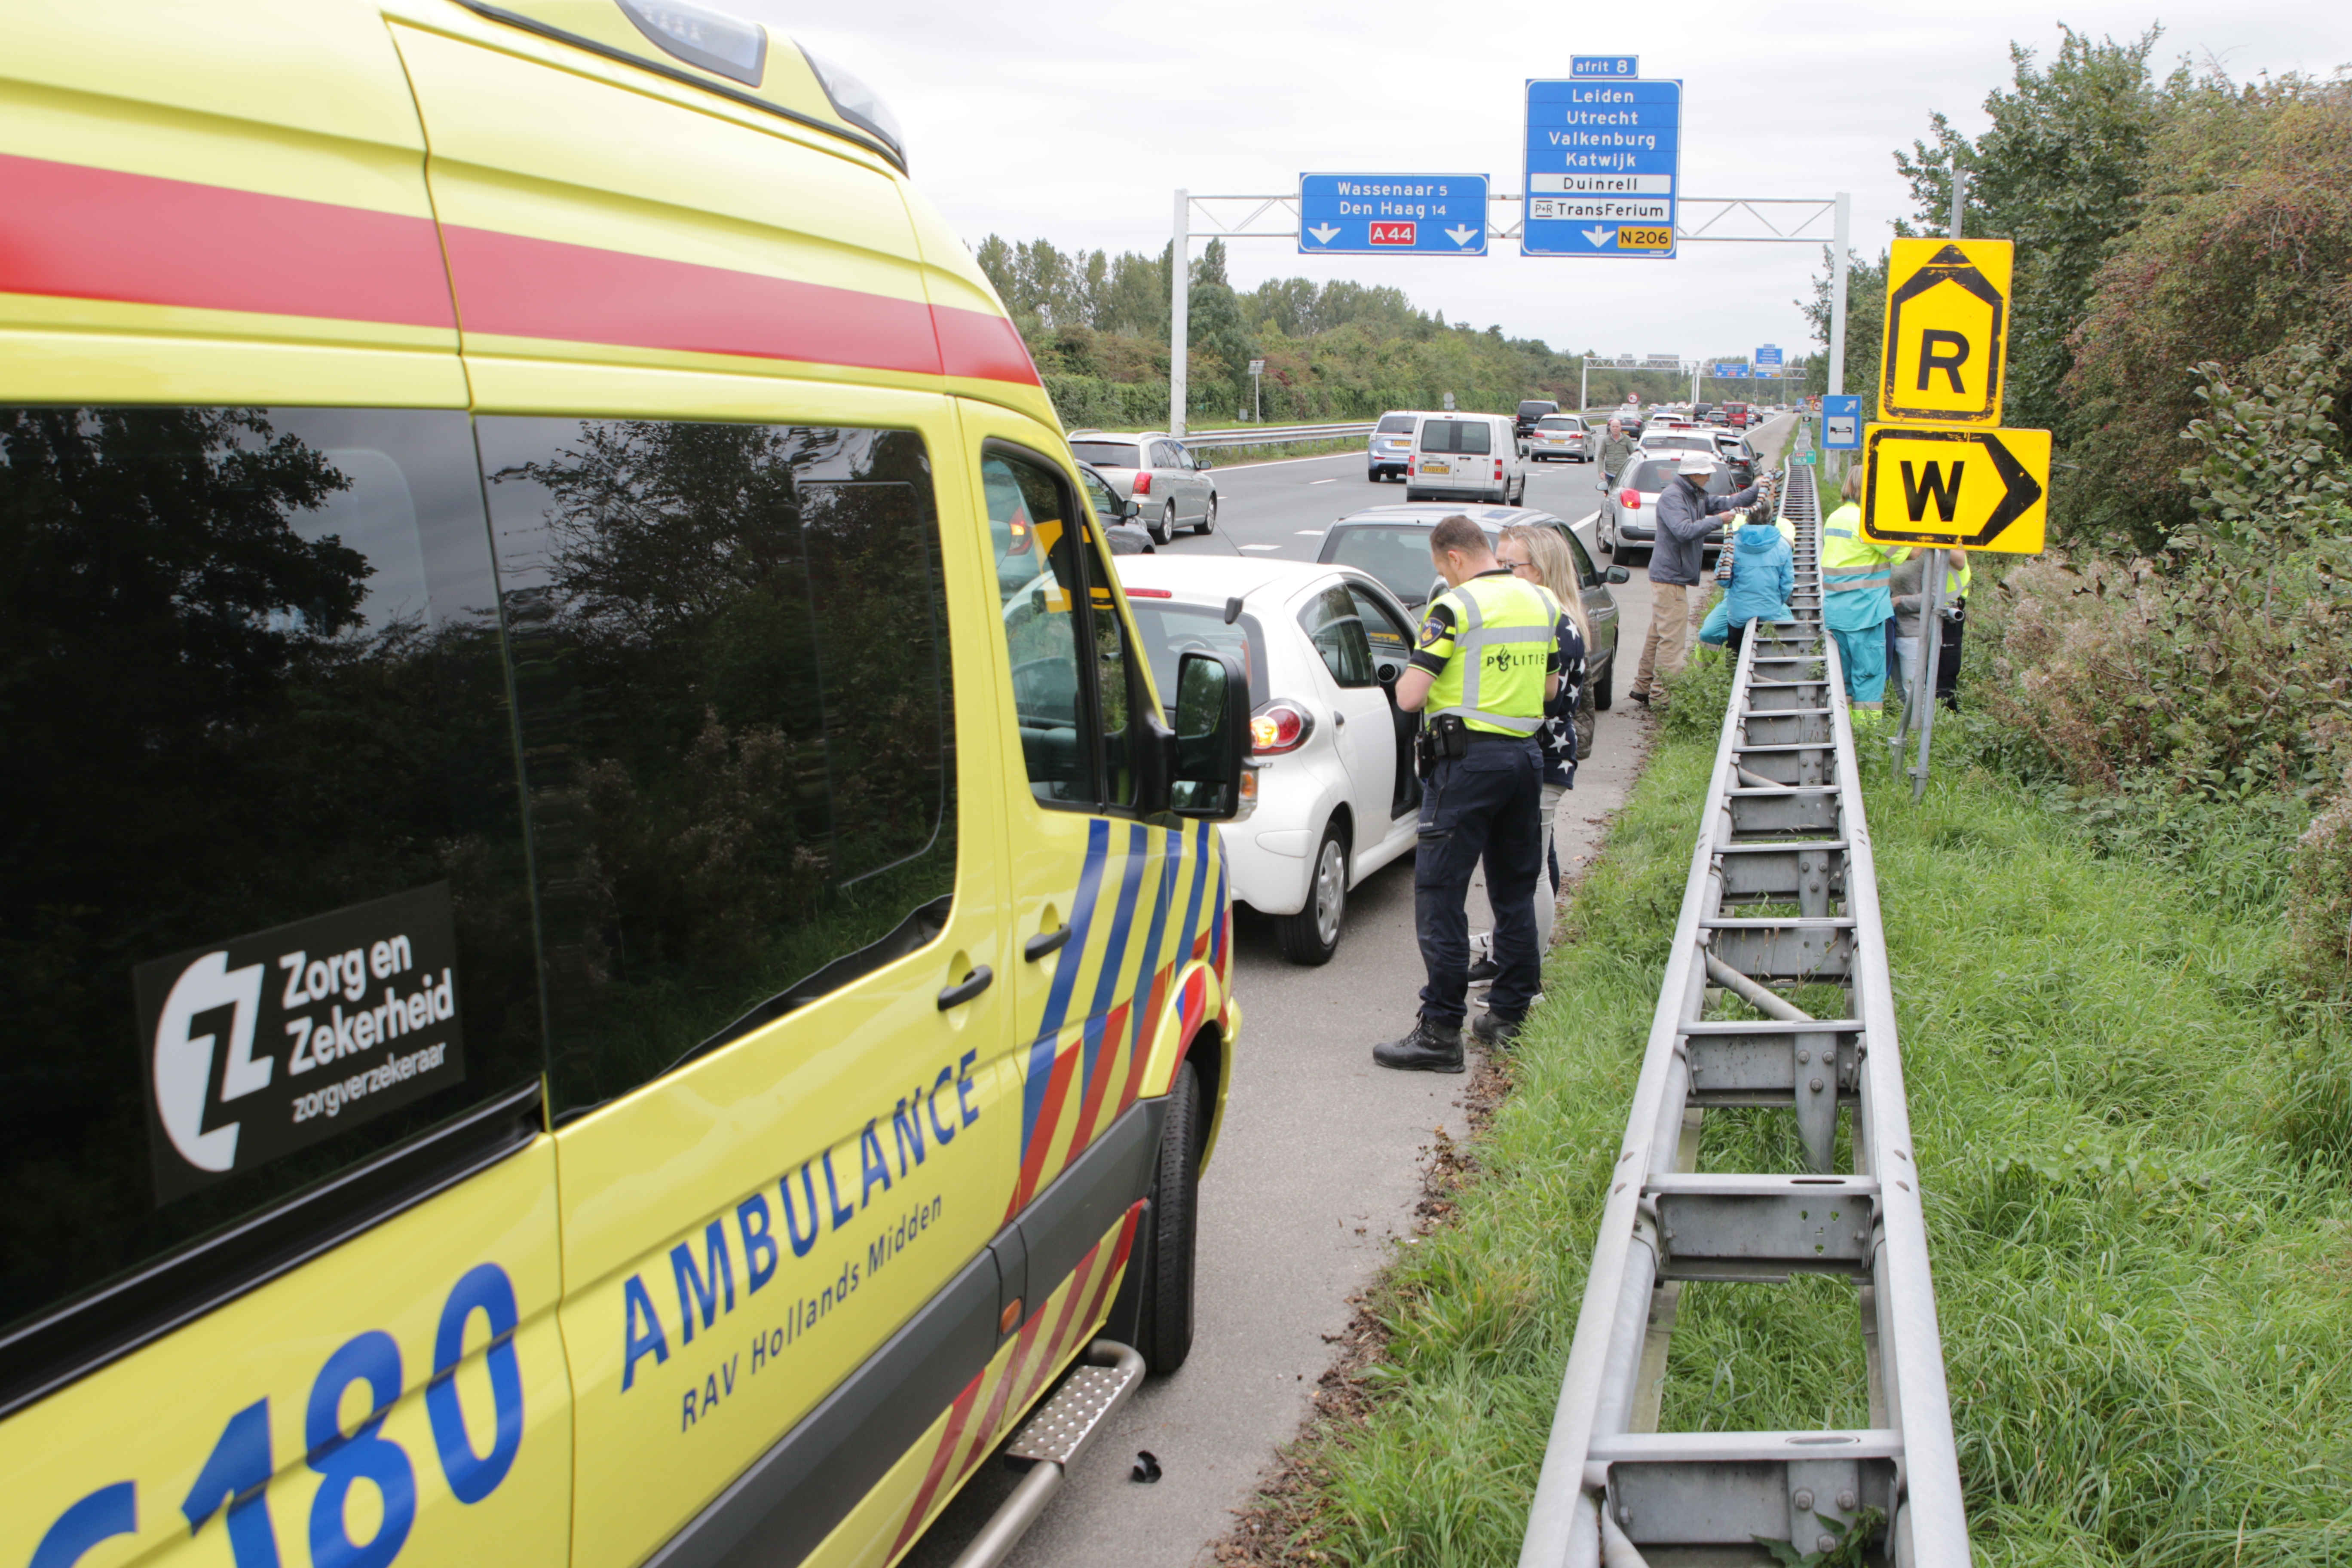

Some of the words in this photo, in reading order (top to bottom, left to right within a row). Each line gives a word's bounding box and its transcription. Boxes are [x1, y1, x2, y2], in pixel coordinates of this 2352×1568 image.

[1576, 61, 1609, 72] afrit
[1617, 60, 1628, 74] 8
[1573, 89, 1634, 103] Leiden
[1567, 110, 1638, 125] Utrecht
[1549, 132, 1656, 150] Valkenburg
[1566, 153, 1636, 171] Katwijk
[1338, 182, 1434, 196] Wassenaar
[1439, 186, 1448, 196] 5
[1564, 177, 1637, 190] Duinrell
[1340, 202, 1372, 215] Den
[1381, 202, 1425, 219] Haag
[1432, 205, 1447, 216] 14
[1535, 204, 1553, 214] P+R
[1557, 203, 1663, 217] TransFerium
[1621, 231, 1668, 244] N206
[1917, 328, 1970, 394] R
[1900, 460, 1965, 522] W
[1487, 650, 1545, 672] POLITIE
[279, 949, 367, 1009] Zorg
[371, 934, 412, 979] en
[286, 968, 454, 1076] Zekerheid
[293, 1042, 446, 1123] zorgverzekeraar
[620, 1047, 980, 1395] AMBULANCE
[682, 1354, 739, 1433] RAV
[752, 1262, 859, 1375] Hollands
[867, 1194, 942, 1278] Midden
